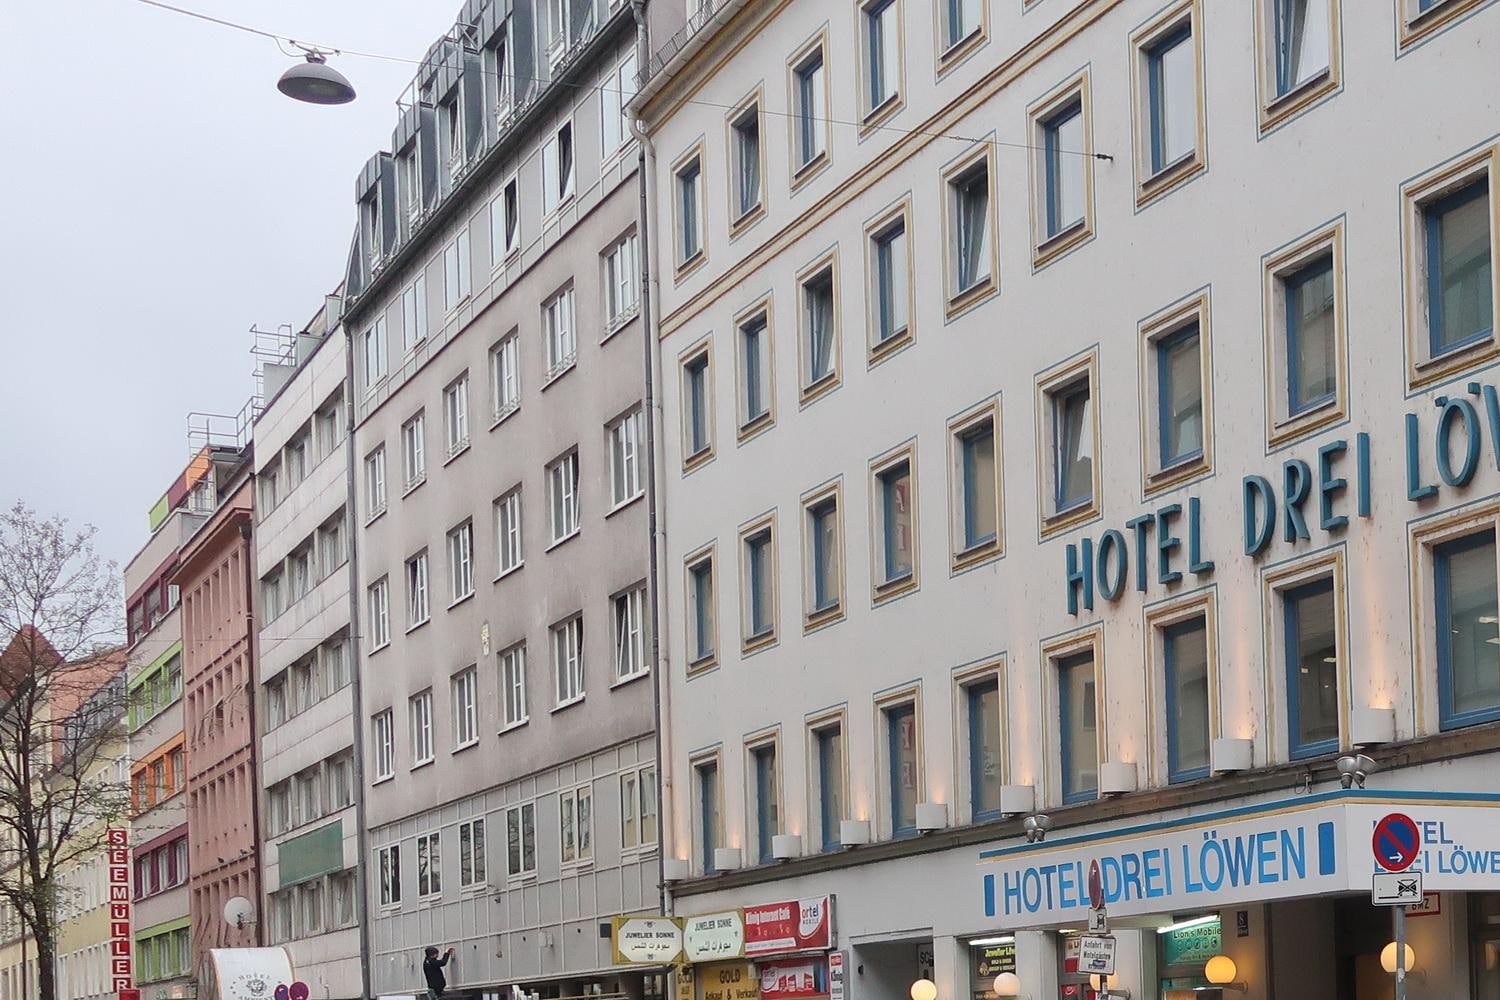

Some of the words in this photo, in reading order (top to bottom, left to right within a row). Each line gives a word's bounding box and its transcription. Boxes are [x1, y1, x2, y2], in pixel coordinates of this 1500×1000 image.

[1066, 496, 1215, 616] HOTEL
[1242, 432, 1370, 558] DREI
[1004, 861, 1090, 915] HOTEL
[1101, 848, 1172, 904] DREI
[1183, 830, 1305, 894] LÖWEN
[112, 831, 128, 990] SEEMÜLLER
[802, 903, 819, 919] ortel
[695, 920, 715, 932] JUWELIER
[717, 918, 732, 928] SONNE
[1196, 927, 1222, 936] Mobile
[1084, 940, 1102, 949] Anfahrt
[719, 968, 741, 984] GOLD
[705, 990, 723, 1000] Ankauf
